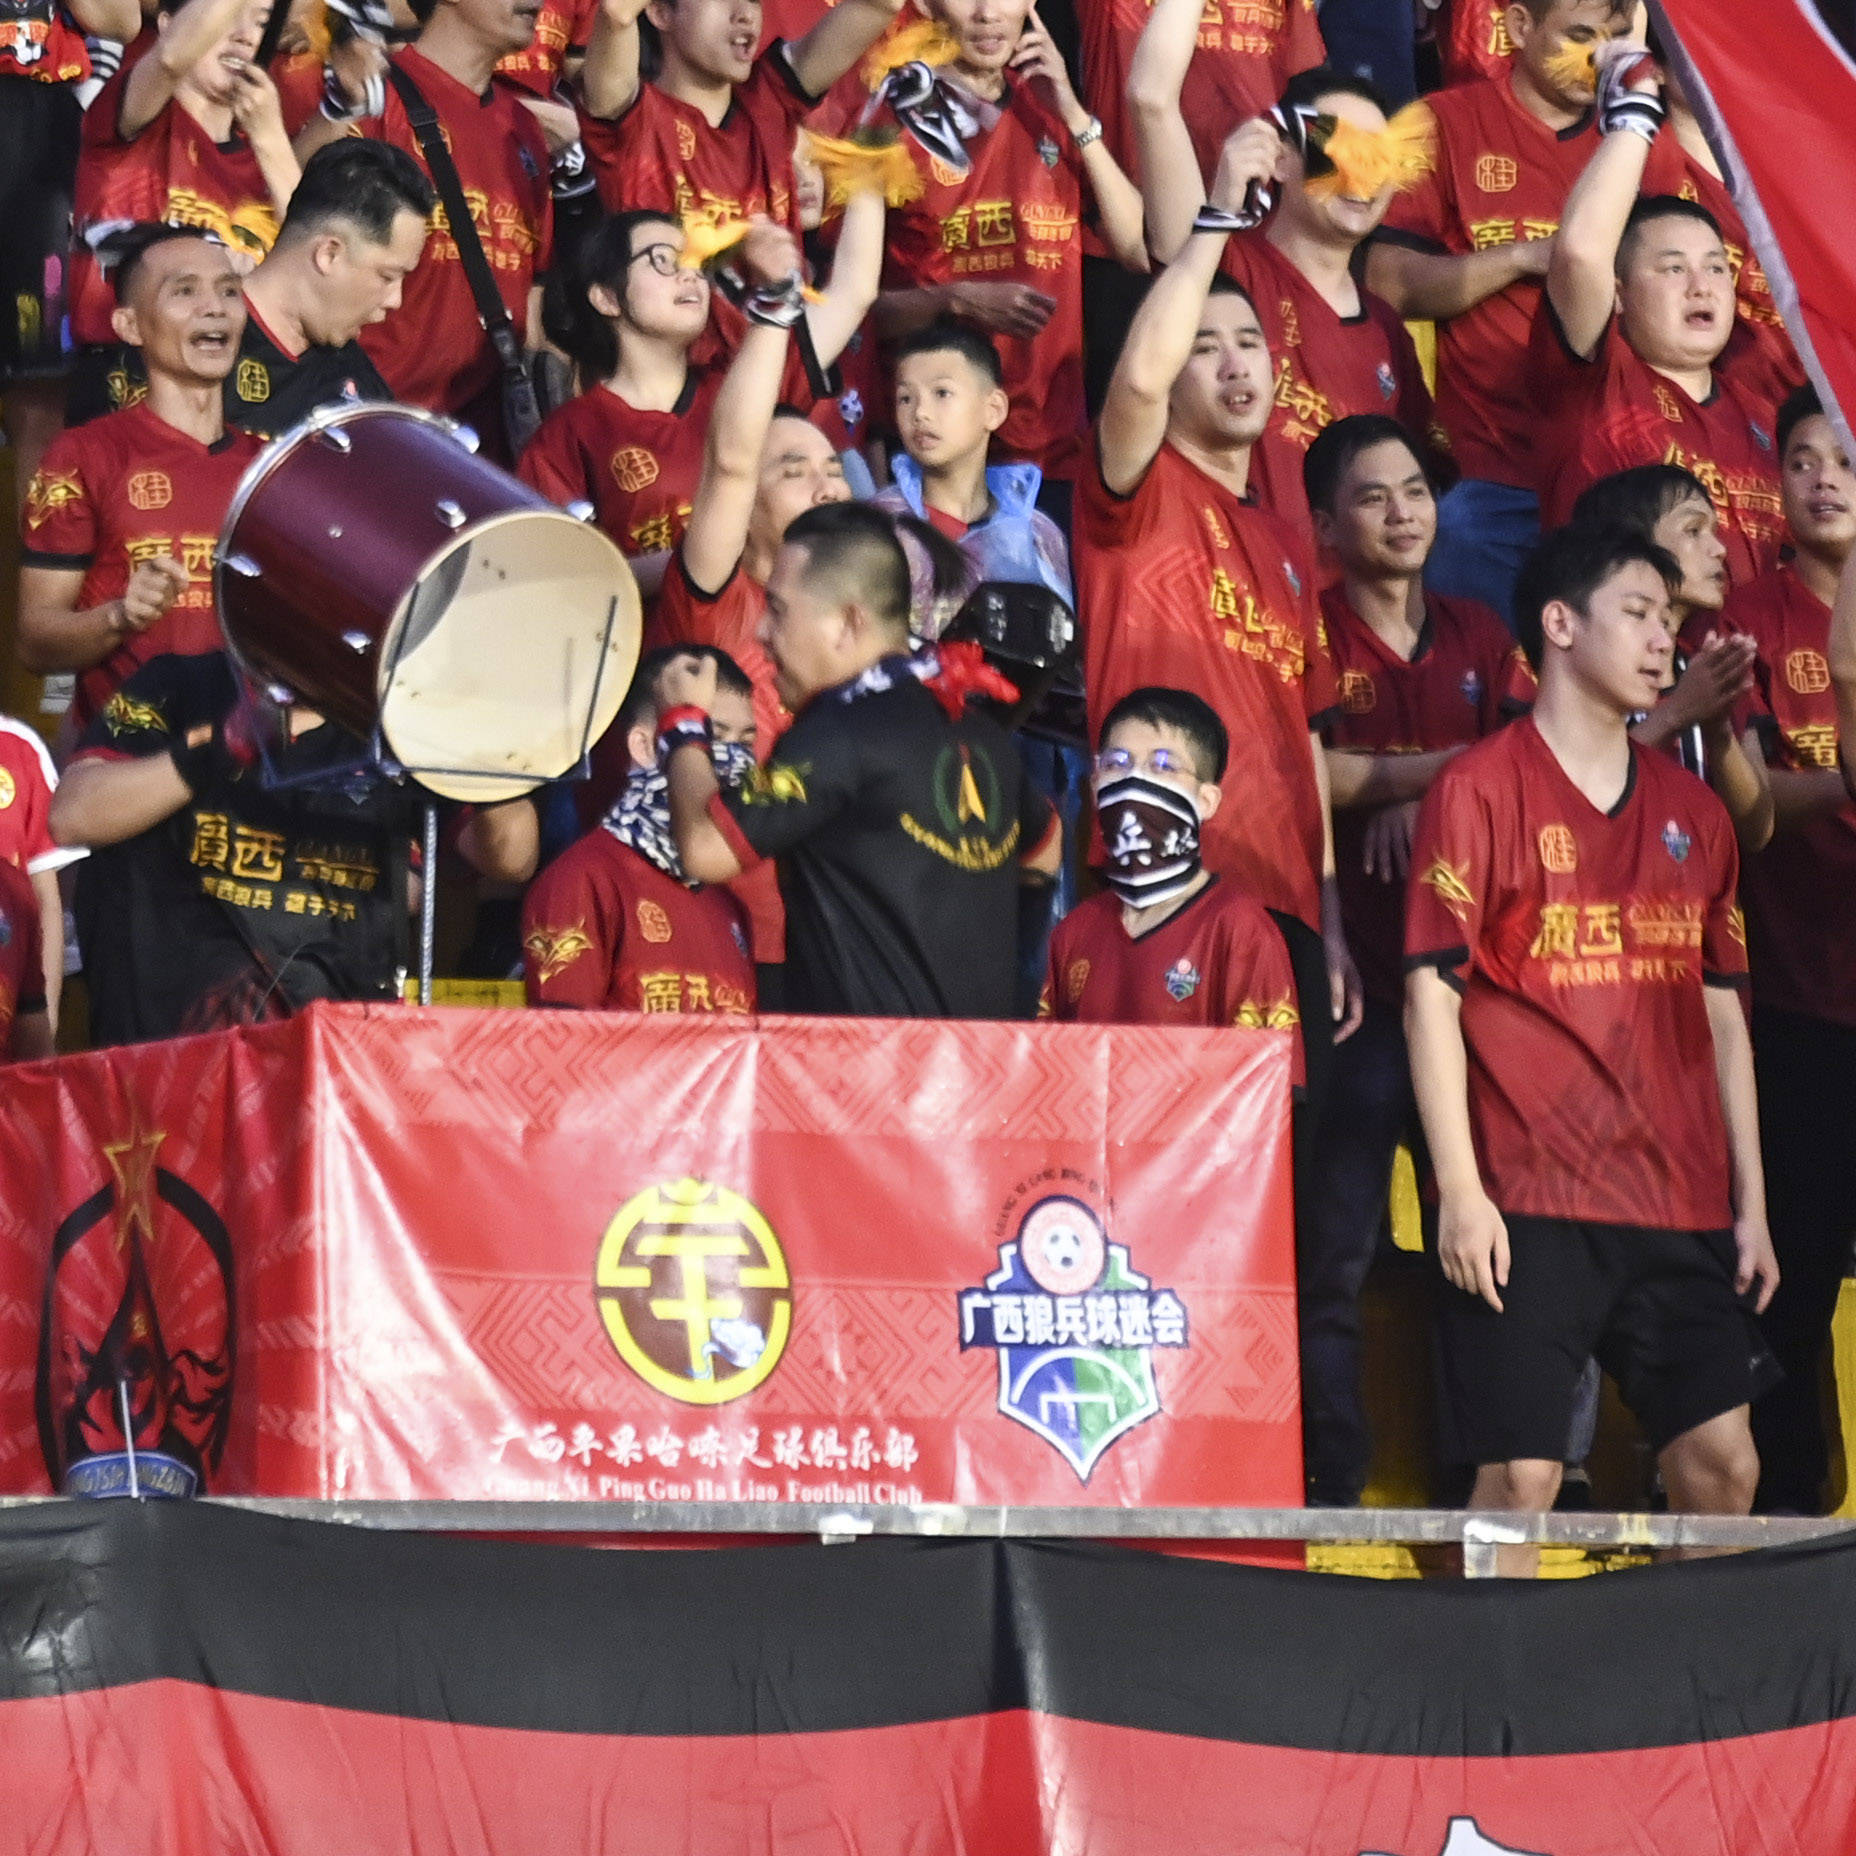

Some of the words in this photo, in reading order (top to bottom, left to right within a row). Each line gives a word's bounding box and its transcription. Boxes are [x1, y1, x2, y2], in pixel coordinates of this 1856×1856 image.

[189, 812, 286, 883] 廣西
[1530, 902, 1623, 959] 廣西
[960, 1291, 1187, 1346] 广西狼兵球迷会
[788, 1479, 871, 1503] Football
